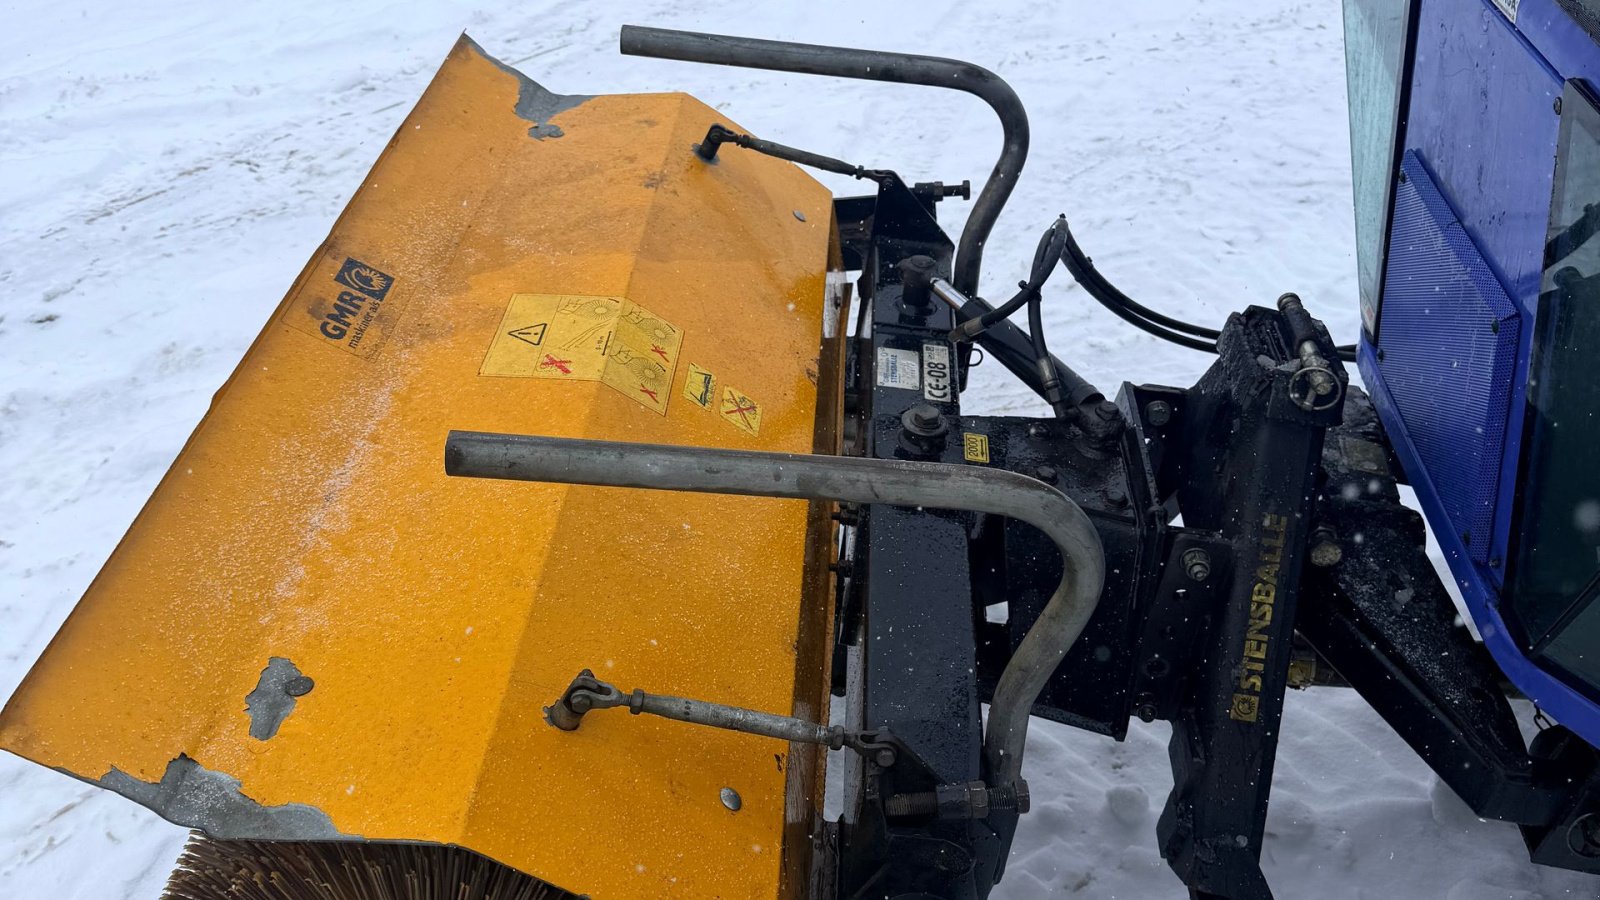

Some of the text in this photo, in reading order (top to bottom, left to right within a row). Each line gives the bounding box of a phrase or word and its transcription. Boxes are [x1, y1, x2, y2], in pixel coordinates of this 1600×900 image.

[320, 291, 367, 340] GMR
[348, 312, 374, 349] maskiner
[968, 437, 979, 457] 2000
[1240, 514, 1288, 692] STENSBALLE
